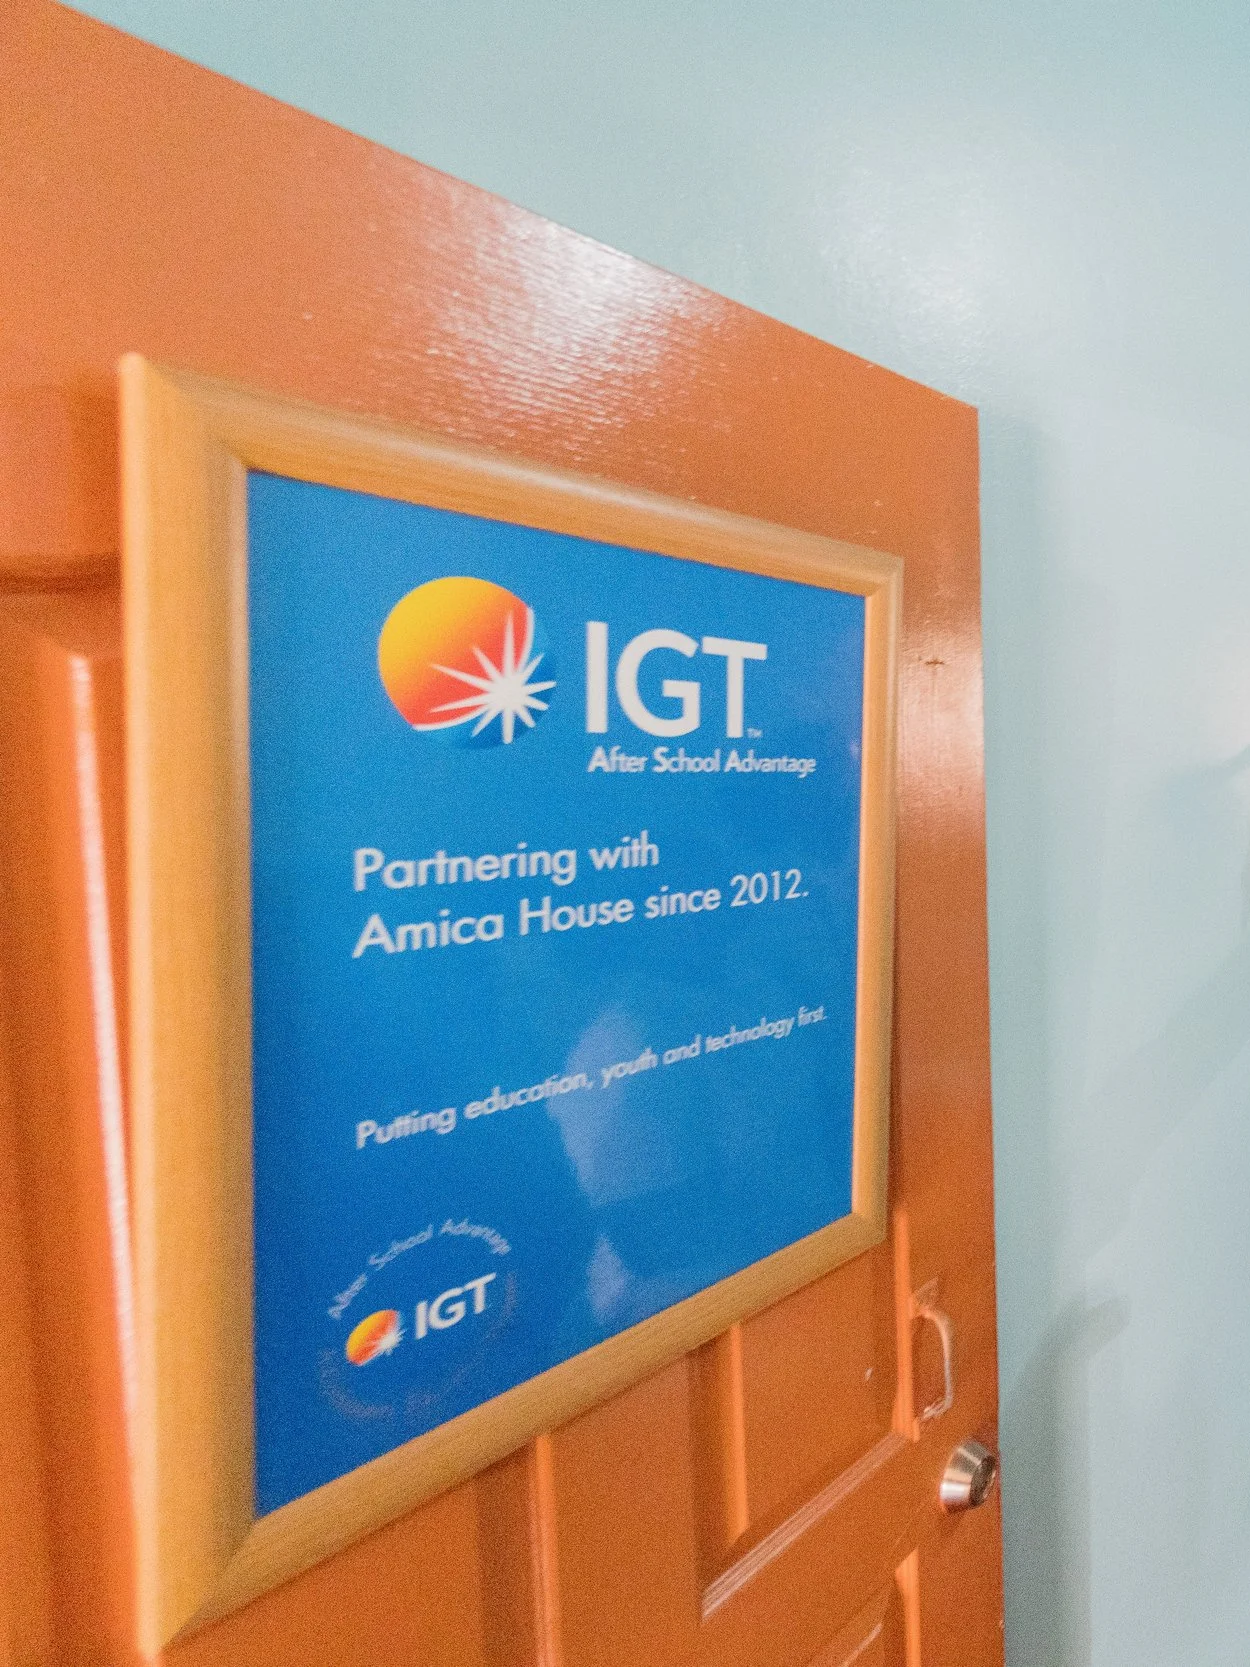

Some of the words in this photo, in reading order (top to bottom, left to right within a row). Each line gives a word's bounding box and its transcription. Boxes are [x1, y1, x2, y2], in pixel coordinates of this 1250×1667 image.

[585, 620, 768, 739] IGT
[588, 746, 648, 773] After
[653, 746, 720, 773] School
[724, 751, 817, 779] Advantage
[354, 842, 577, 891] Partnering
[589, 830, 660, 871] with
[352, 909, 505, 959] Amica
[520, 896, 635, 936] House
[645, 886, 721, 918] since
[730, 869, 809, 907] 2012.
[356, 1108, 457, 1149] Putting
[463, 1073, 594, 1120] education,
[600, 1049, 658, 1090] youth
[662, 1035, 702, 1066] and
[705, 1017, 795, 1054] technology
[797, 1006, 828, 1027] first.
[415, 1272, 497, 1340] IGT
